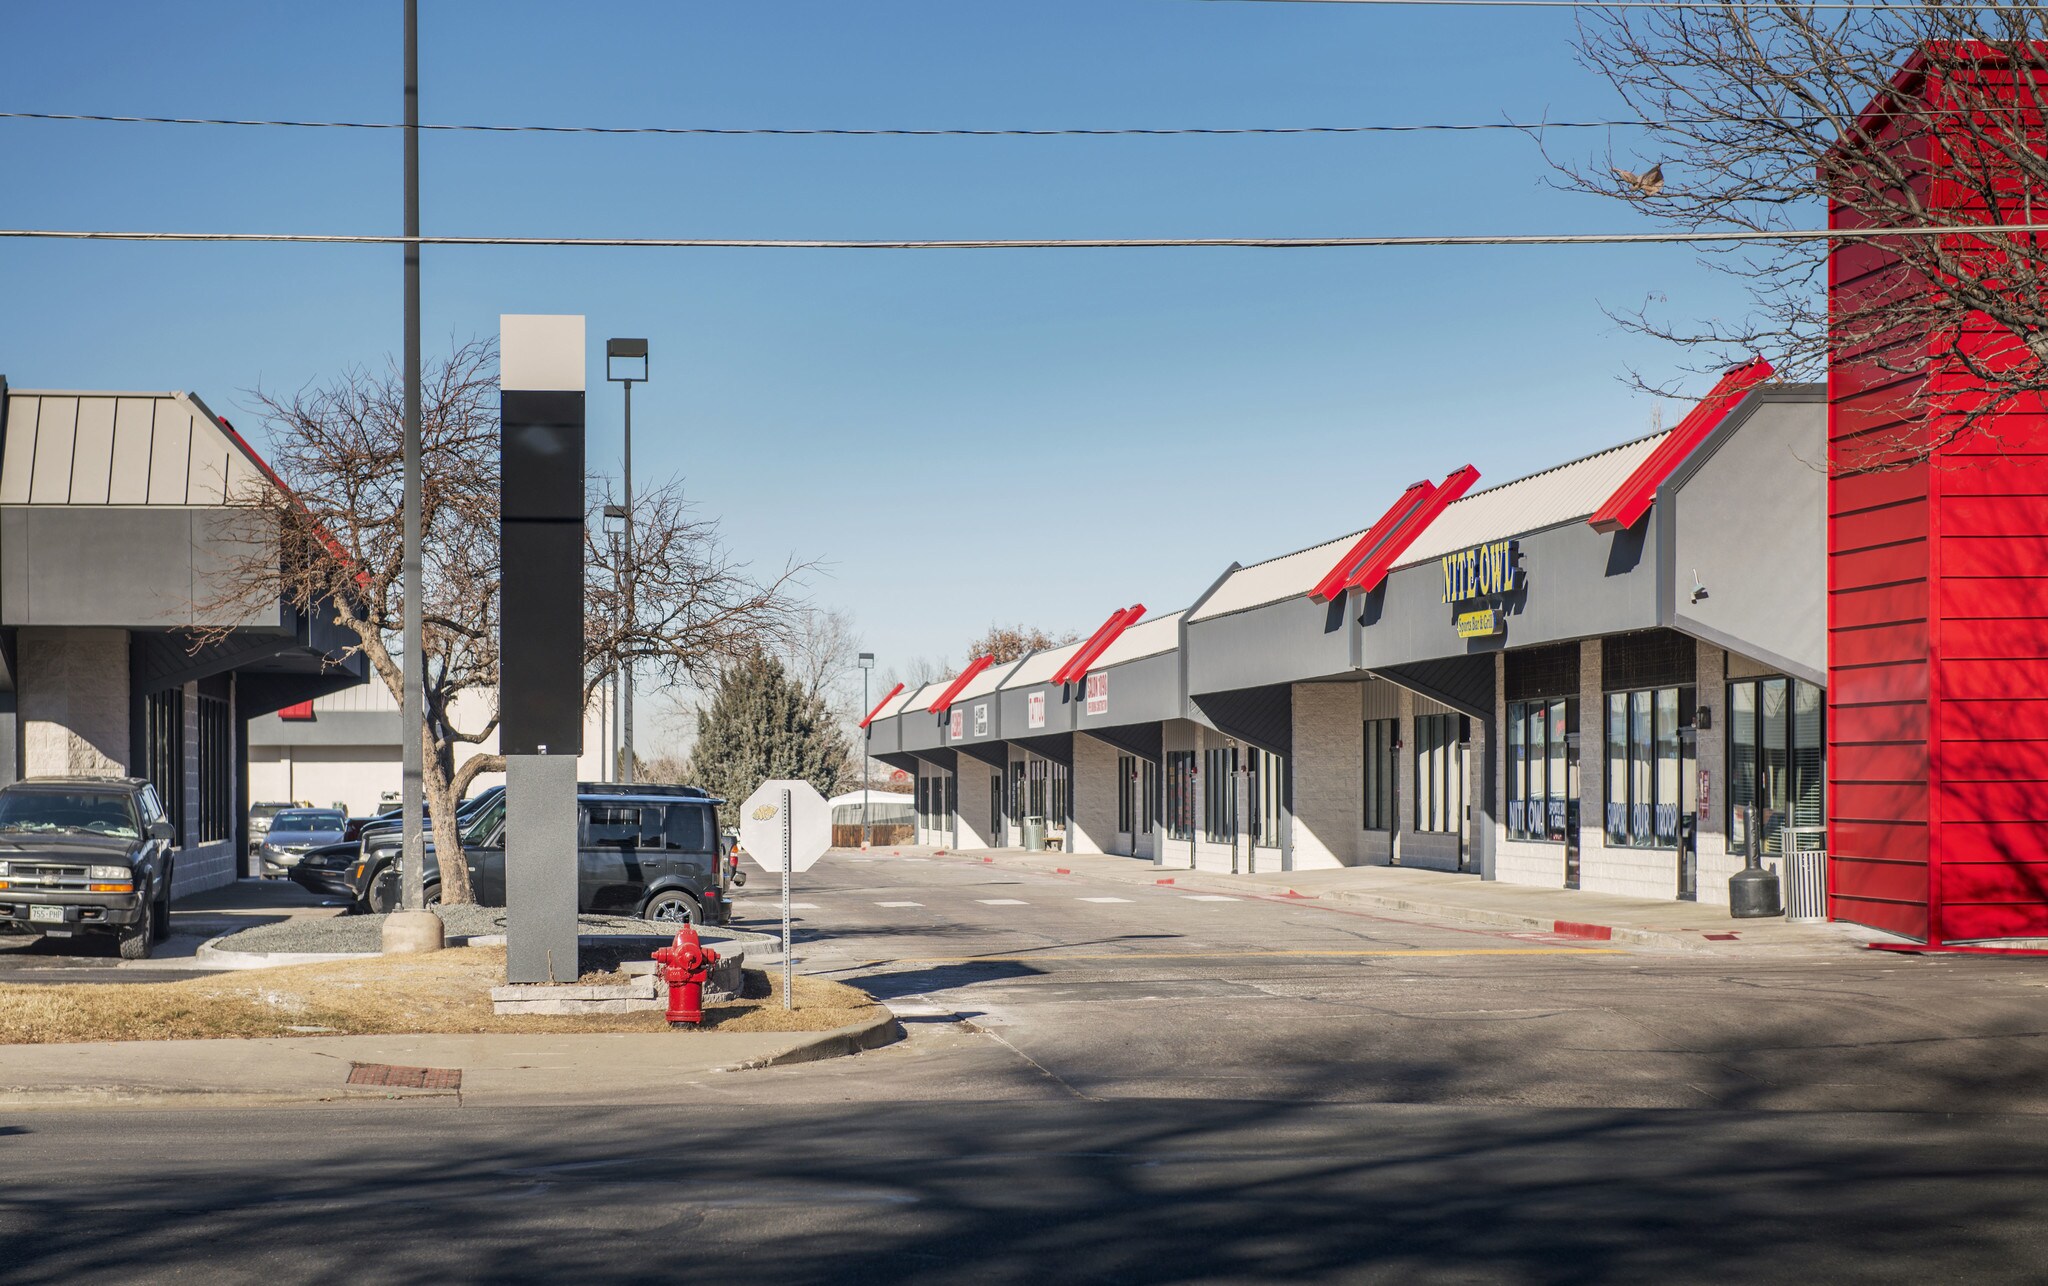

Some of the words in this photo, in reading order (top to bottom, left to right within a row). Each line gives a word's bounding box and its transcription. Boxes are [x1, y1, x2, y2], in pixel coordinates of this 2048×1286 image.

[1442, 550, 1477, 604] NITE
[1479, 540, 1515, 595] OWL
[1458, 617, 1471, 635] Sports
[1472, 616, 1480, 631] Bar
[1633, 803, 1650, 836] OUR
